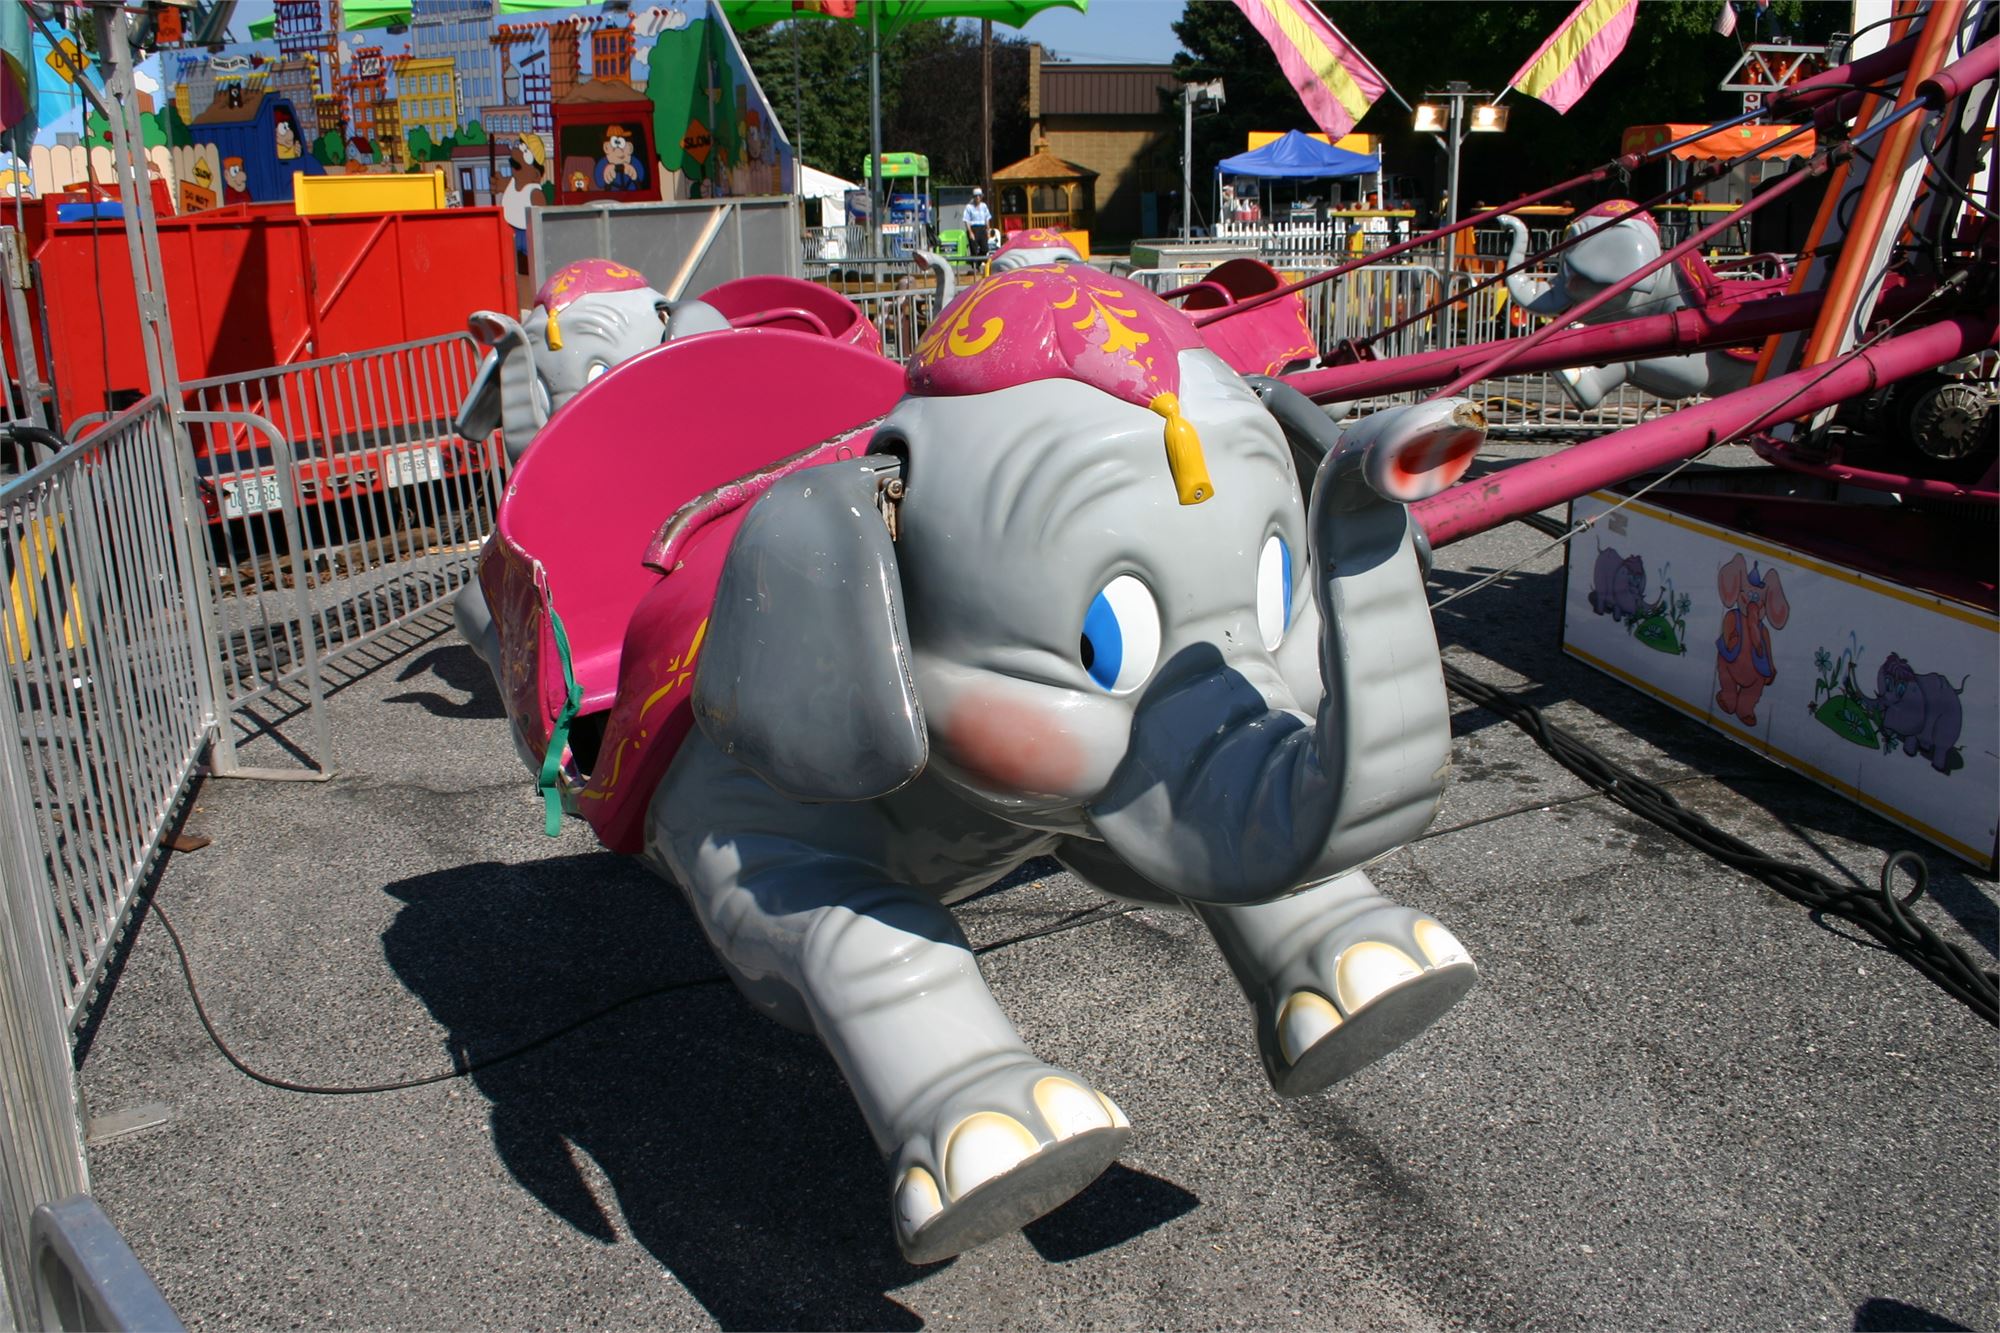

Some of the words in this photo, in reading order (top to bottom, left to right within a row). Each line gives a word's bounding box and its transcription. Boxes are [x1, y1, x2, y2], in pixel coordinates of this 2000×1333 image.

[683, 135, 711, 149] SLOW
[195, 167, 212, 180] SLOW
[195, 194, 209, 208] NOT
